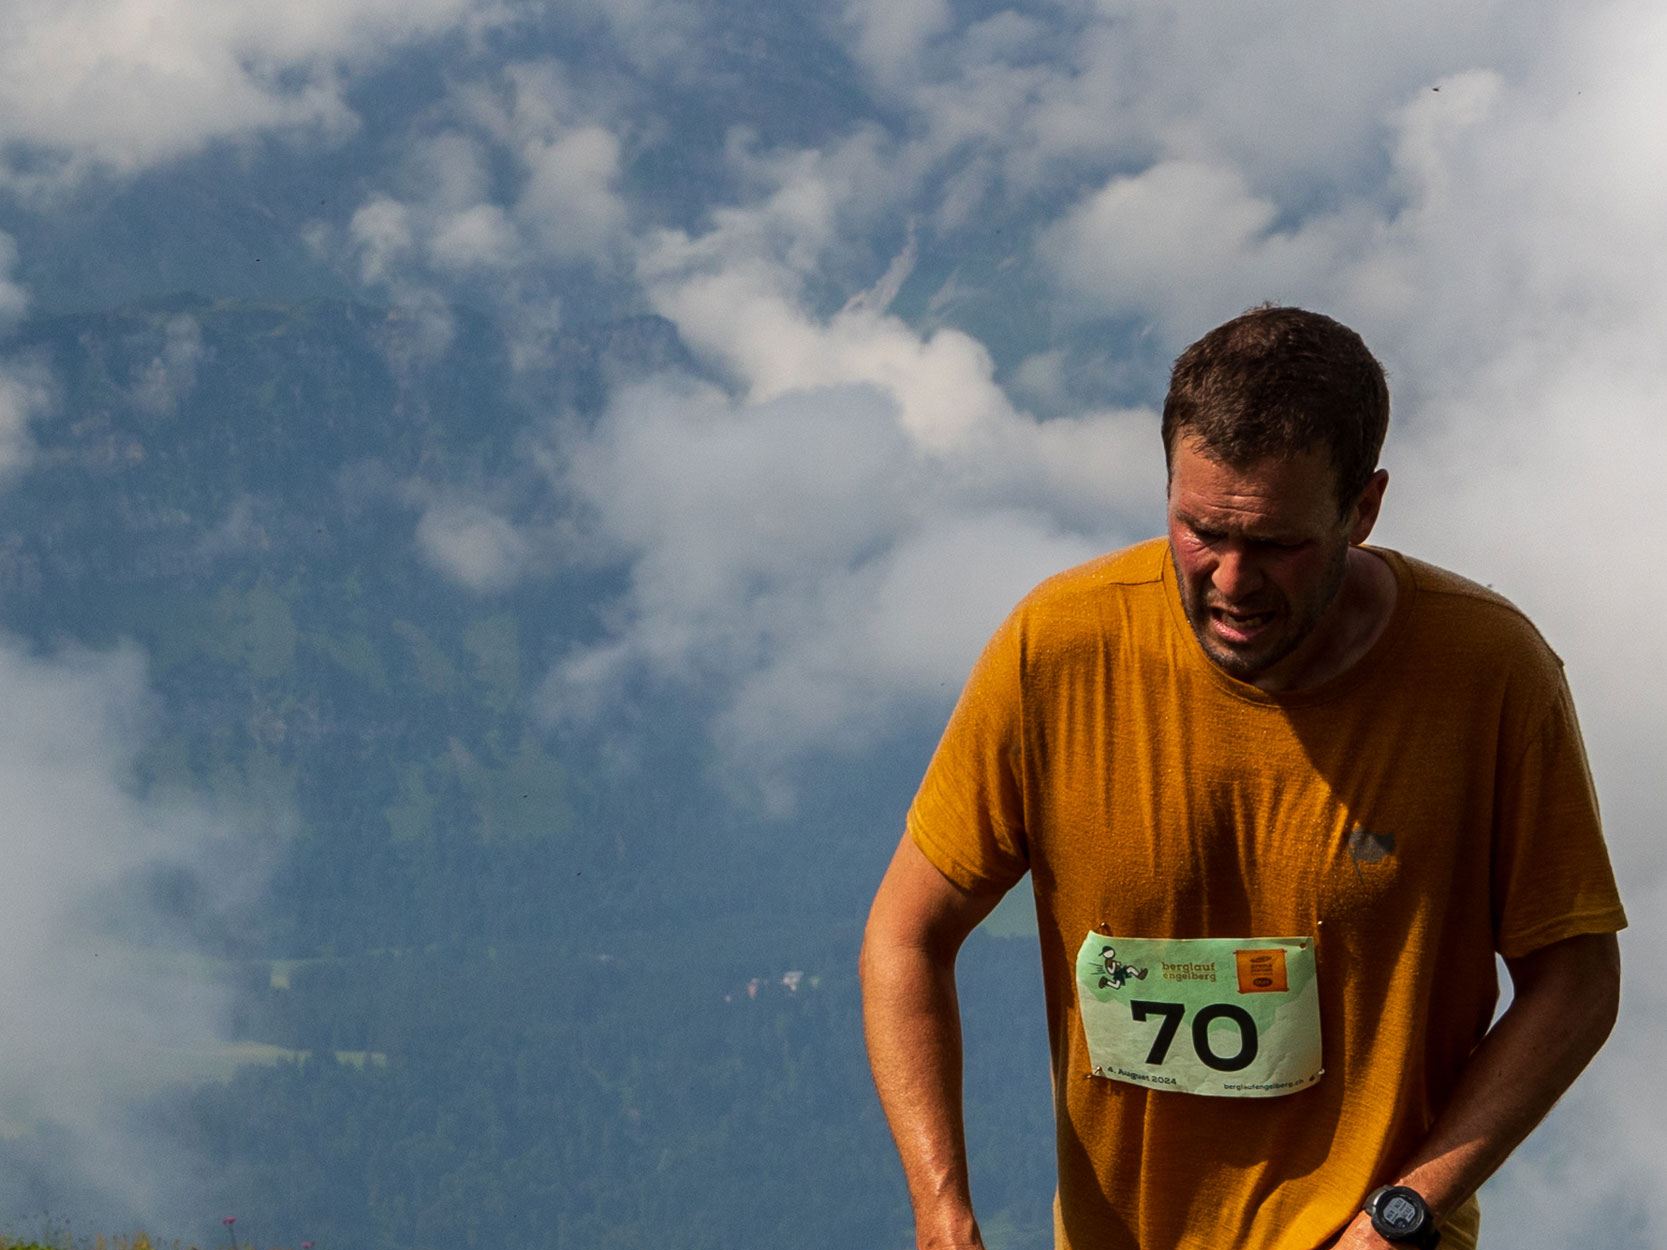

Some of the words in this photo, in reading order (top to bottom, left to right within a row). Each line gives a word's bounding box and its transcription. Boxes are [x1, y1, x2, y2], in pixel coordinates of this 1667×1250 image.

[1161, 961, 1216, 973] berglauf
[1163, 972, 1217, 982] engelberg
[1130, 1000, 1258, 1072] 70
[1118, 1068, 1150, 1080] August
[1151, 1075, 1177, 1085] 2024
